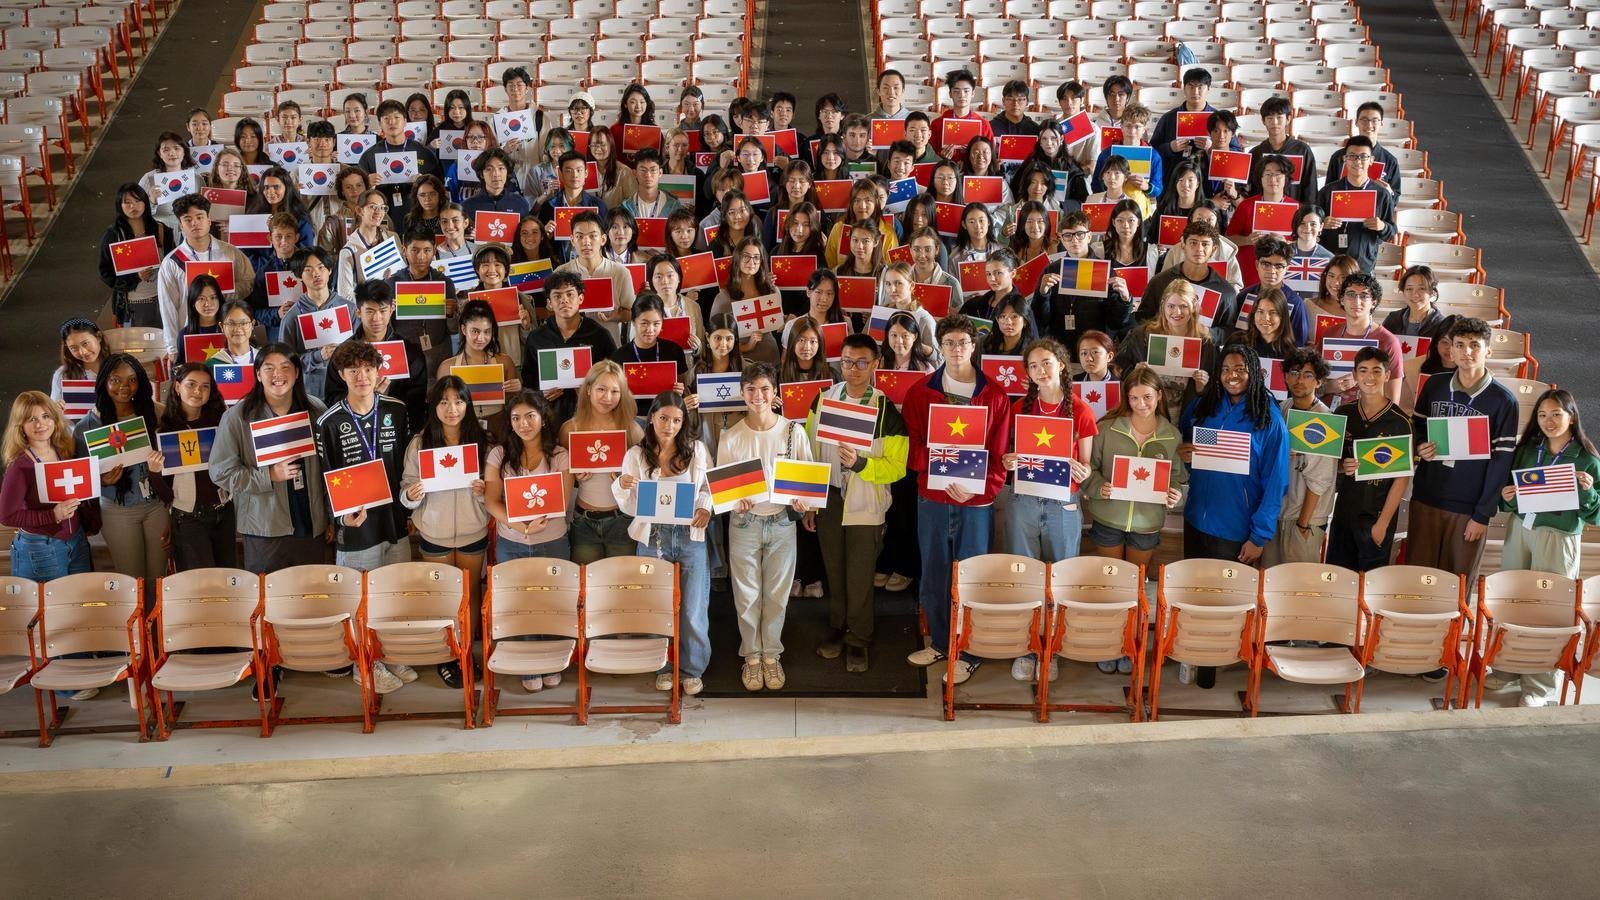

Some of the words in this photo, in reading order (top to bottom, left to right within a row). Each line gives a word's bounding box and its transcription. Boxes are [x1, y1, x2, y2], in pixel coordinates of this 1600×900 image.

[551, 566, 556, 575] 6
[645, 565, 650, 574] 7
[1108, 565, 1113, 574] 2
[1227, 569, 1232, 577] 3
[333, 573, 339, 582] 4
[434, 571, 439, 580] 5
[1326, 573, 1332, 581] 4
[1426, 575, 1431, 584] 5
[109, 581, 114, 590] 2
[231, 577, 236, 586] 3
[1542, 580, 1547, 588] 6
